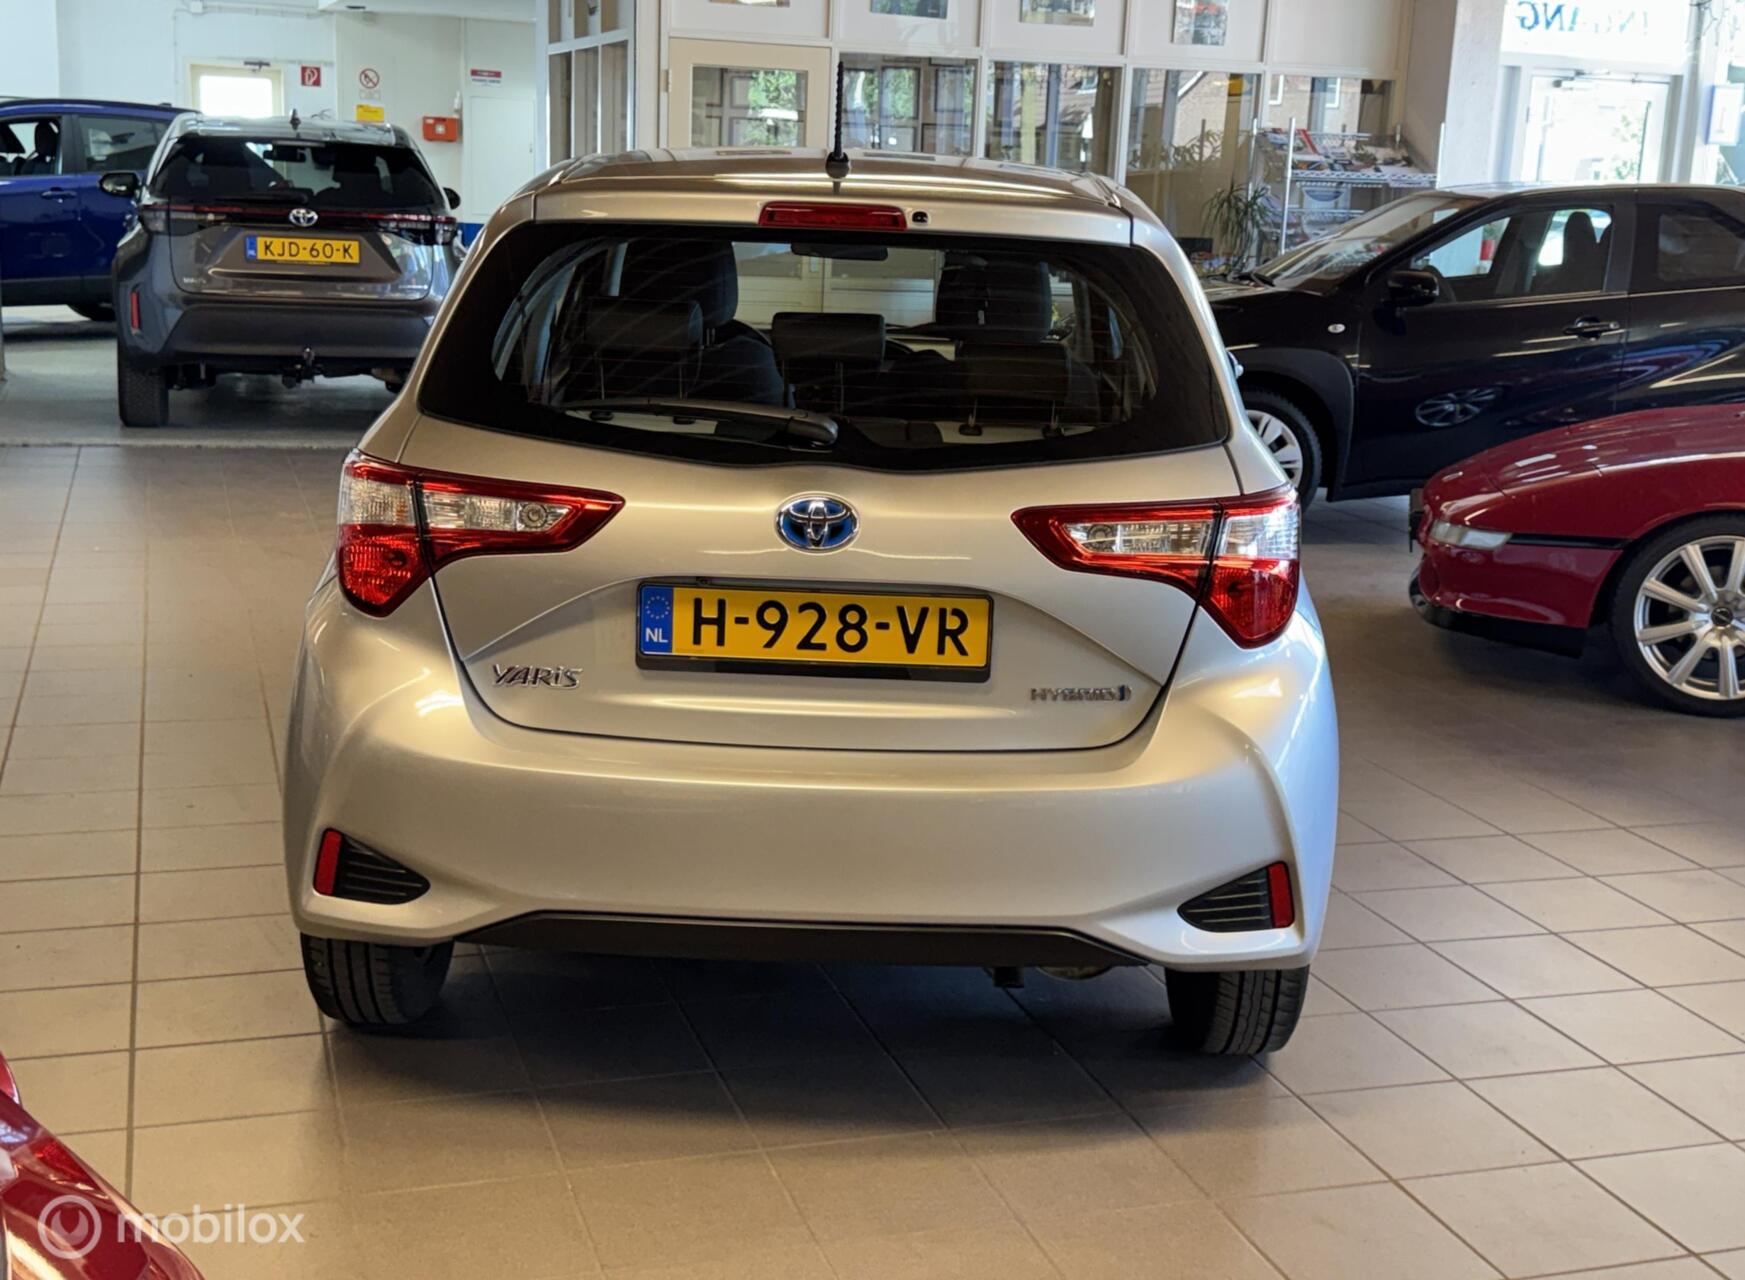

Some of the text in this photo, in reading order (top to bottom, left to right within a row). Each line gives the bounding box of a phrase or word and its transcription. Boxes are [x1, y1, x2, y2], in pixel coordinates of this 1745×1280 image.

[264, 240, 353, 260] KJD-60-K
[645, 628, 668, 643] NL
[693, 598, 969, 656] H-928-VR
